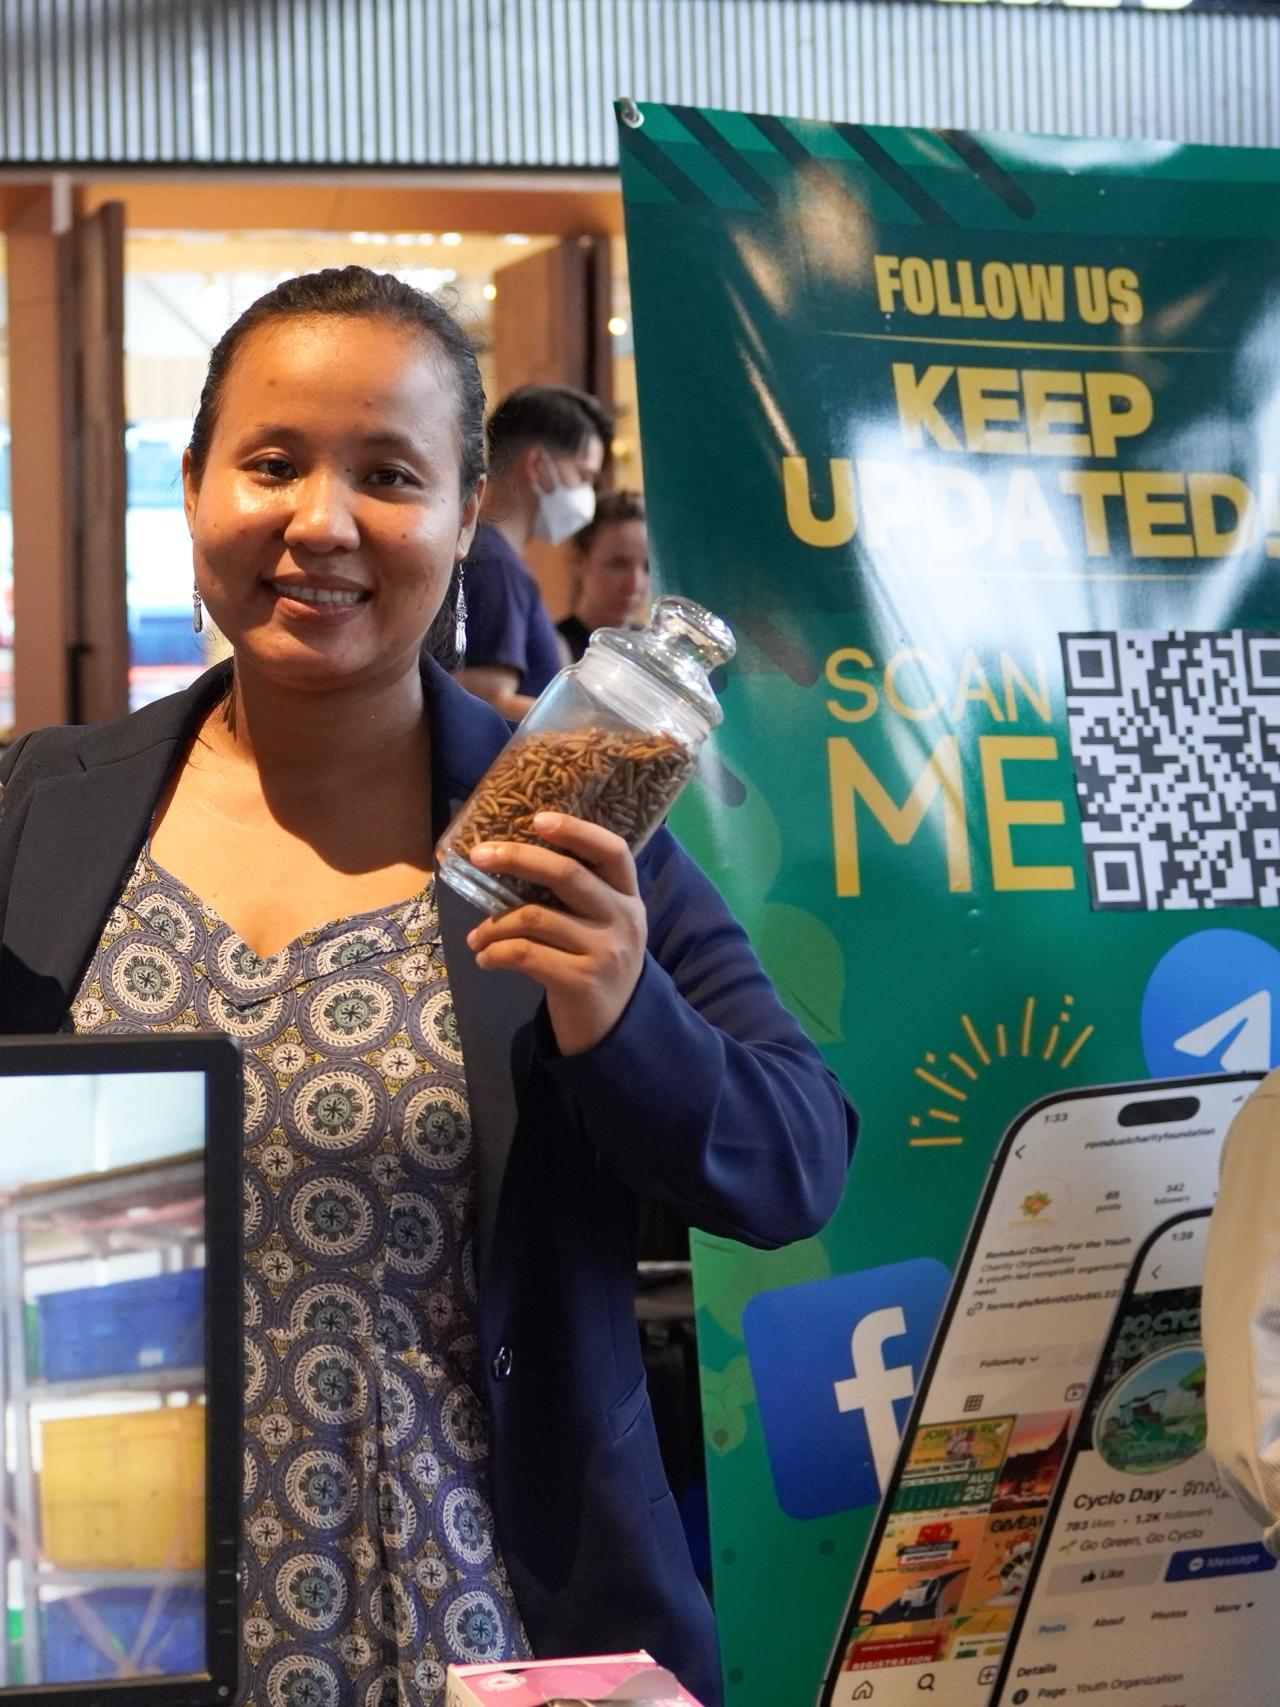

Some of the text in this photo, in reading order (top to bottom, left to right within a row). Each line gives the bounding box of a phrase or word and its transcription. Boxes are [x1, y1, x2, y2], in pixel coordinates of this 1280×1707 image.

[874, 255, 1143, 325] FOLLOW US
[892, 363, 1154, 458] KEEP
[825, 647, 1053, 724] SCAN
[827, 735, 1076, 897] ME
[963, 1486, 986, 1501] 25
[1073, 1490, 1125, 1511] Cyclo
[1128, 1487, 1166, 1504] Day
[1080, 1540, 1098, 1552] Go
[1145, 1532, 1165, 1545] Go
[1167, 1528, 1204, 1543] Cyclo
[1205, 1553, 1260, 1569] Message
[1100, 1568, 1124, 1581] Like
[1151, 1609, 1188, 1621] Photos
[1214, 1602, 1241, 1614] More
[1038, 1623, 1067, 1635] Posts
[1093, 1616, 1126, 1628] About
[1016, 1663, 1057, 1677] Details
[1037, 1673, 1184, 1699] Page Youth Organization
